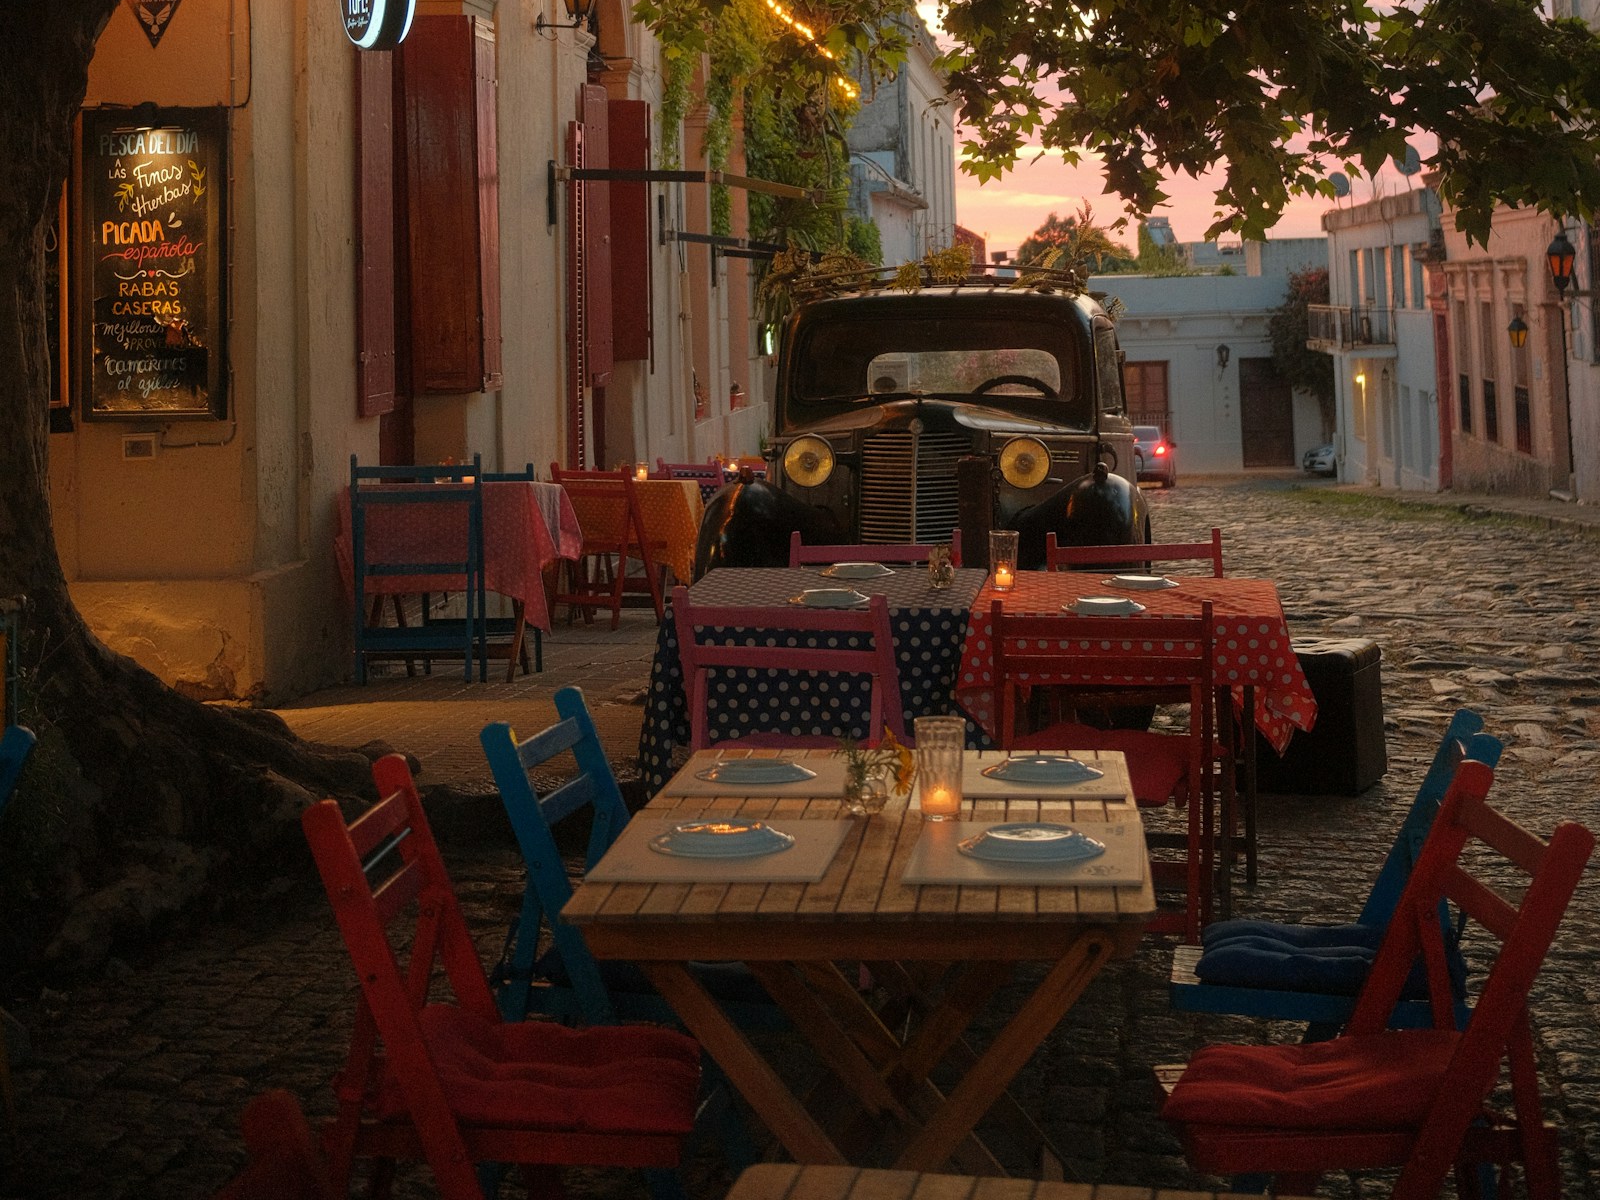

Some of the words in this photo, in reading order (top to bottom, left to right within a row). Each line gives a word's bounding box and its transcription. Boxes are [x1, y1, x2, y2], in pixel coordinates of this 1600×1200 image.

[99, 133, 145, 156] PESCA
[148, 132, 174, 154] DEL
[176, 128, 199, 154] DÍA
[109, 168, 127, 179] LAS
[115, 158, 122, 168] A
[133, 161, 183, 189] Finas
[131, 179, 192, 218] Hierbas
[102, 219, 165, 245] PICADA
[101, 235, 204, 269] española
[119, 281, 179, 297] RABAS
[113, 300, 182, 315] CASERAS
